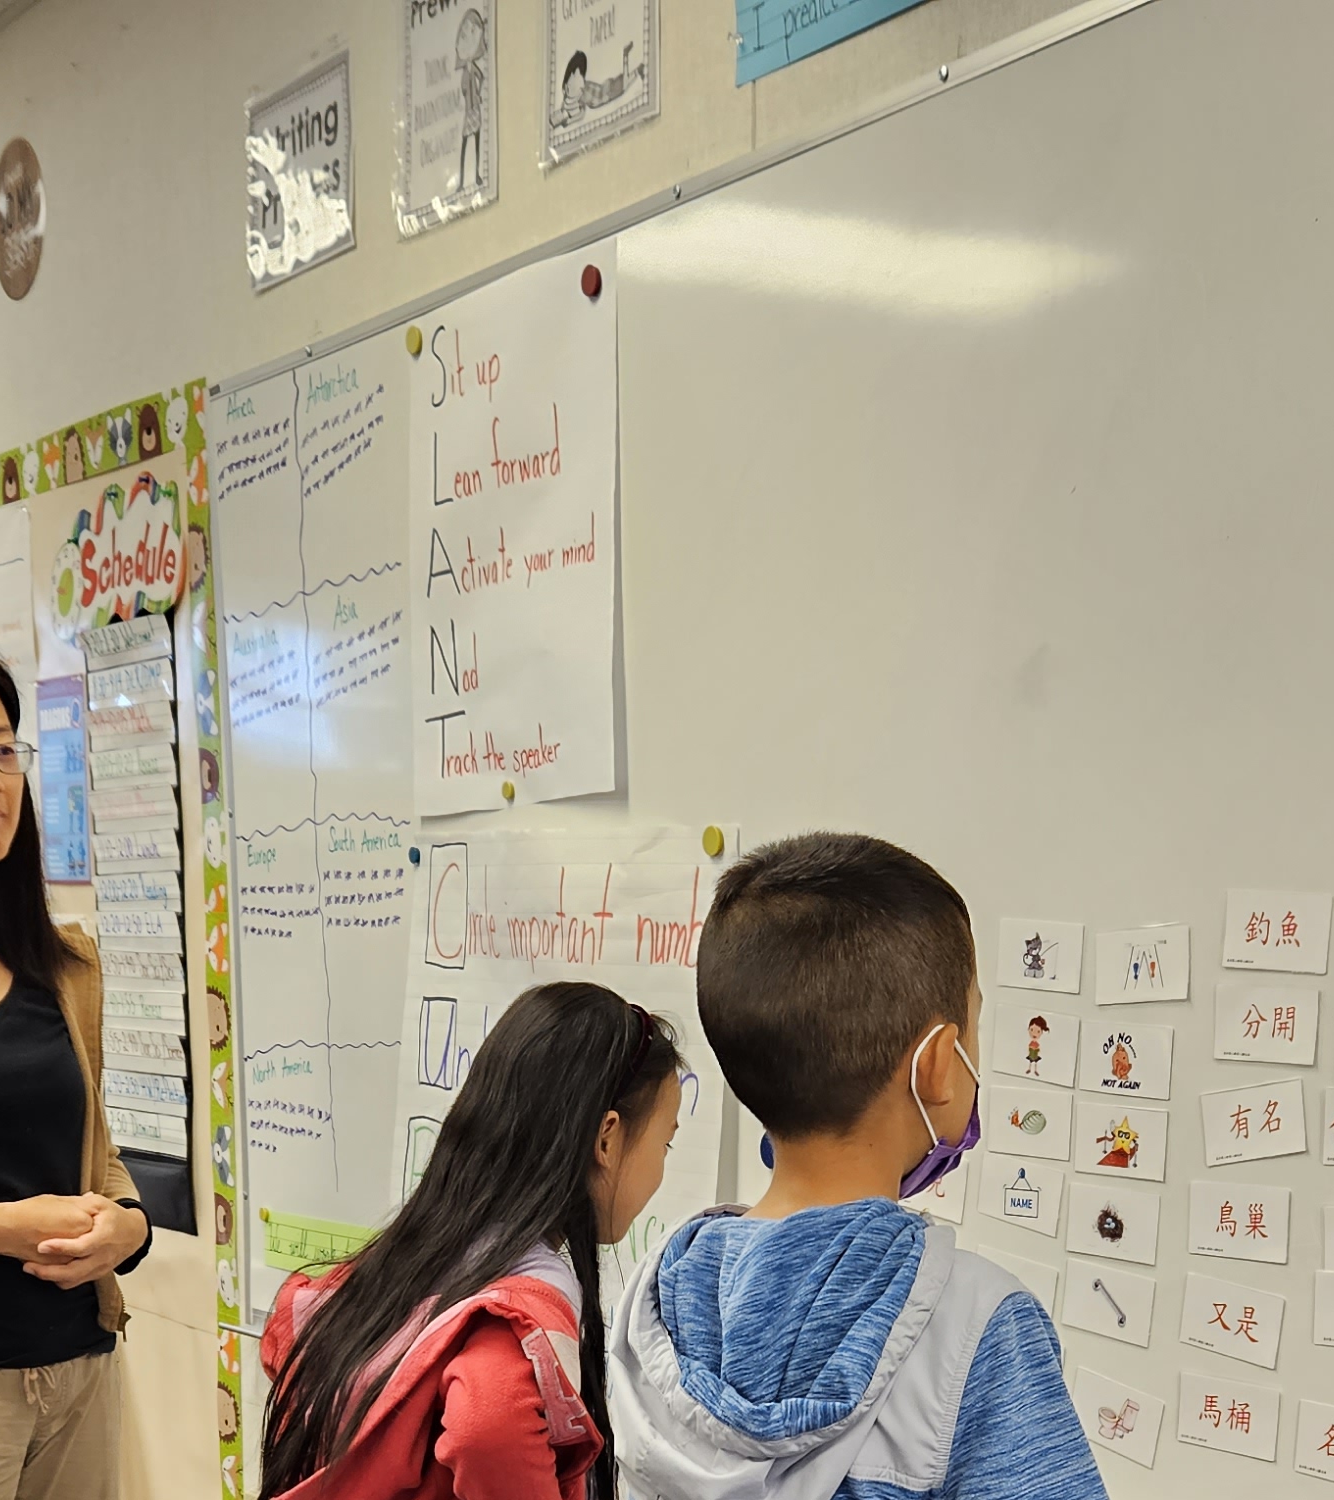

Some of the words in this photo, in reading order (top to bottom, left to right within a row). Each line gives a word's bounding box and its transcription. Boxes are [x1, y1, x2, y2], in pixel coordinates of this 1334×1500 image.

[753, 2, 765, 51] I
[275, 101, 338, 157] riting
[430, 324, 466, 408] Sit
[475, 353, 501, 402] up
[433, 431, 483, 507] Lean
[490, 402, 563, 501] forward
[79, 521, 178, 609] Schedule
[427, 527, 513, 598] Activate
[524, 545, 556, 589] your
[562, 511, 596, 567] mind
[333, 594, 359, 631] Asia
[429, 618, 480, 697] Nod
[425, 710, 479, 779] Track
[482, 731, 509, 772] the
[512, 722, 563, 778] speaker
[247, 844, 277, 872] Europe
[328, 825, 356, 853] South
[361, 832, 402, 853] America
[433, 862, 501, 960] Circle
[507, 862, 614, 974] important
[636, 865, 704, 969] numb
[1243, 910, 1302, 949] 釣魚
[1103, 1034, 1115, 1054] OH
[1241, 1003, 1298, 1044] 分開
[252, 1061, 277, 1085] North
[281, 1057, 313, 1078] America
[1101, 1079, 1117, 1088] NOT
[1118, 1080, 1141, 1089] AGAIN
[1228, 1099, 1282, 1141] 有名
[1010, 1197, 1033, 1211] NAME
[1215, 1201, 1270, 1240] 鳥巢
[1207, 1302, 1260, 1344] 又是
[1198, 1395, 1252, 1434] 馬桶
